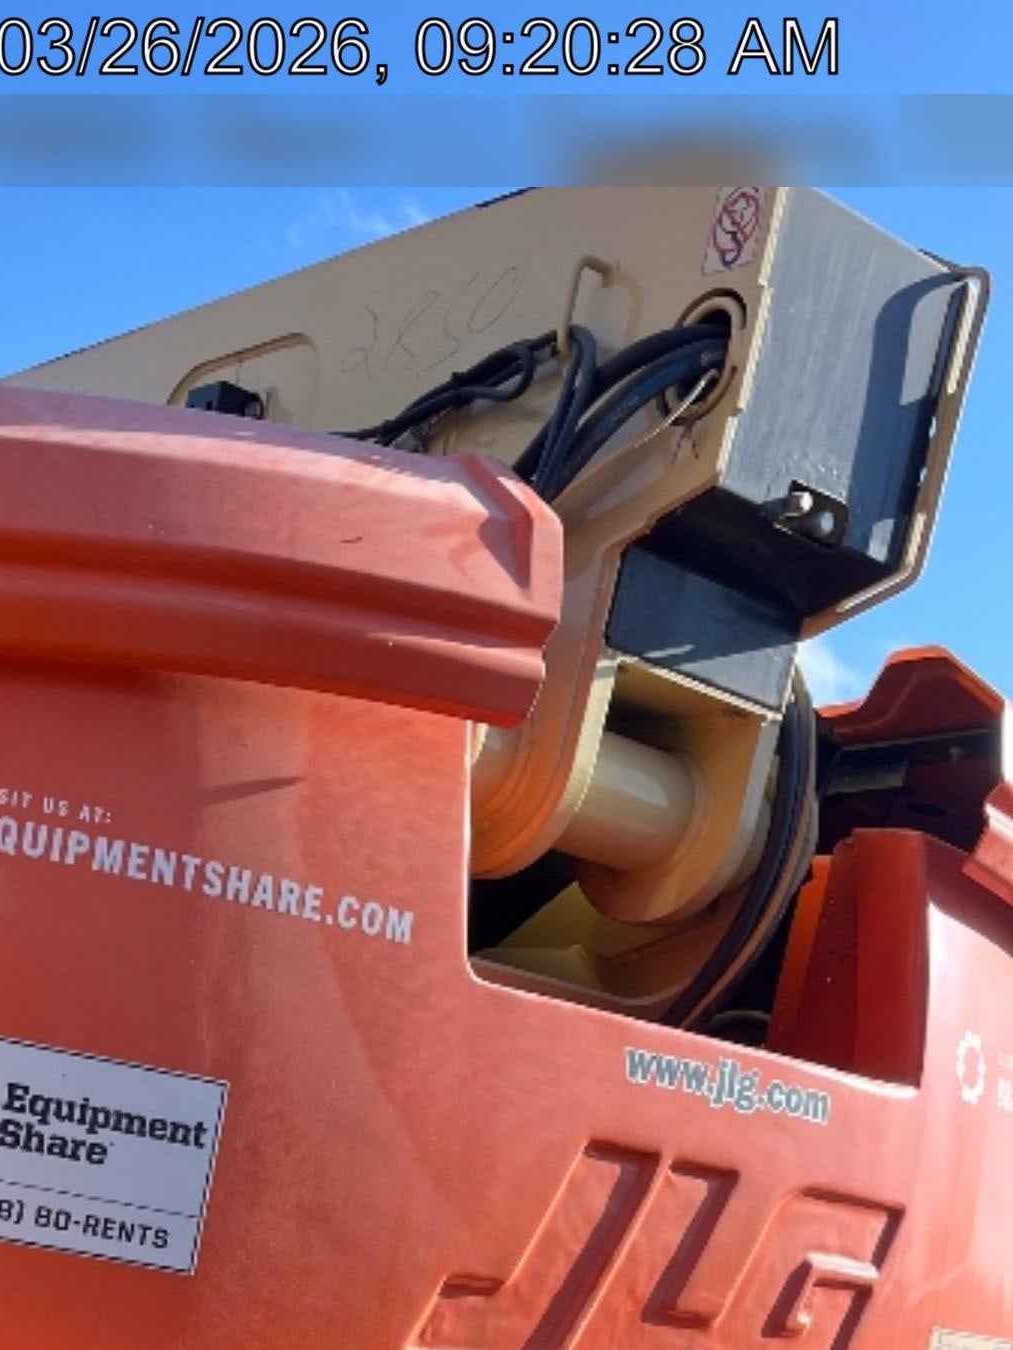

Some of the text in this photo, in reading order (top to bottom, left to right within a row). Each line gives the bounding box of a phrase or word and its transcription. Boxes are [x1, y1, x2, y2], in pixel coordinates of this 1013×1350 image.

[42, 797, 69, 817] US
[78, 803, 112, 823] AT:
[624, 1047, 832, 1125] www.jlg.com
[2, 1081, 208, 1149] Equipment
[34, 1205, 170, 1250] 80-RENTS
